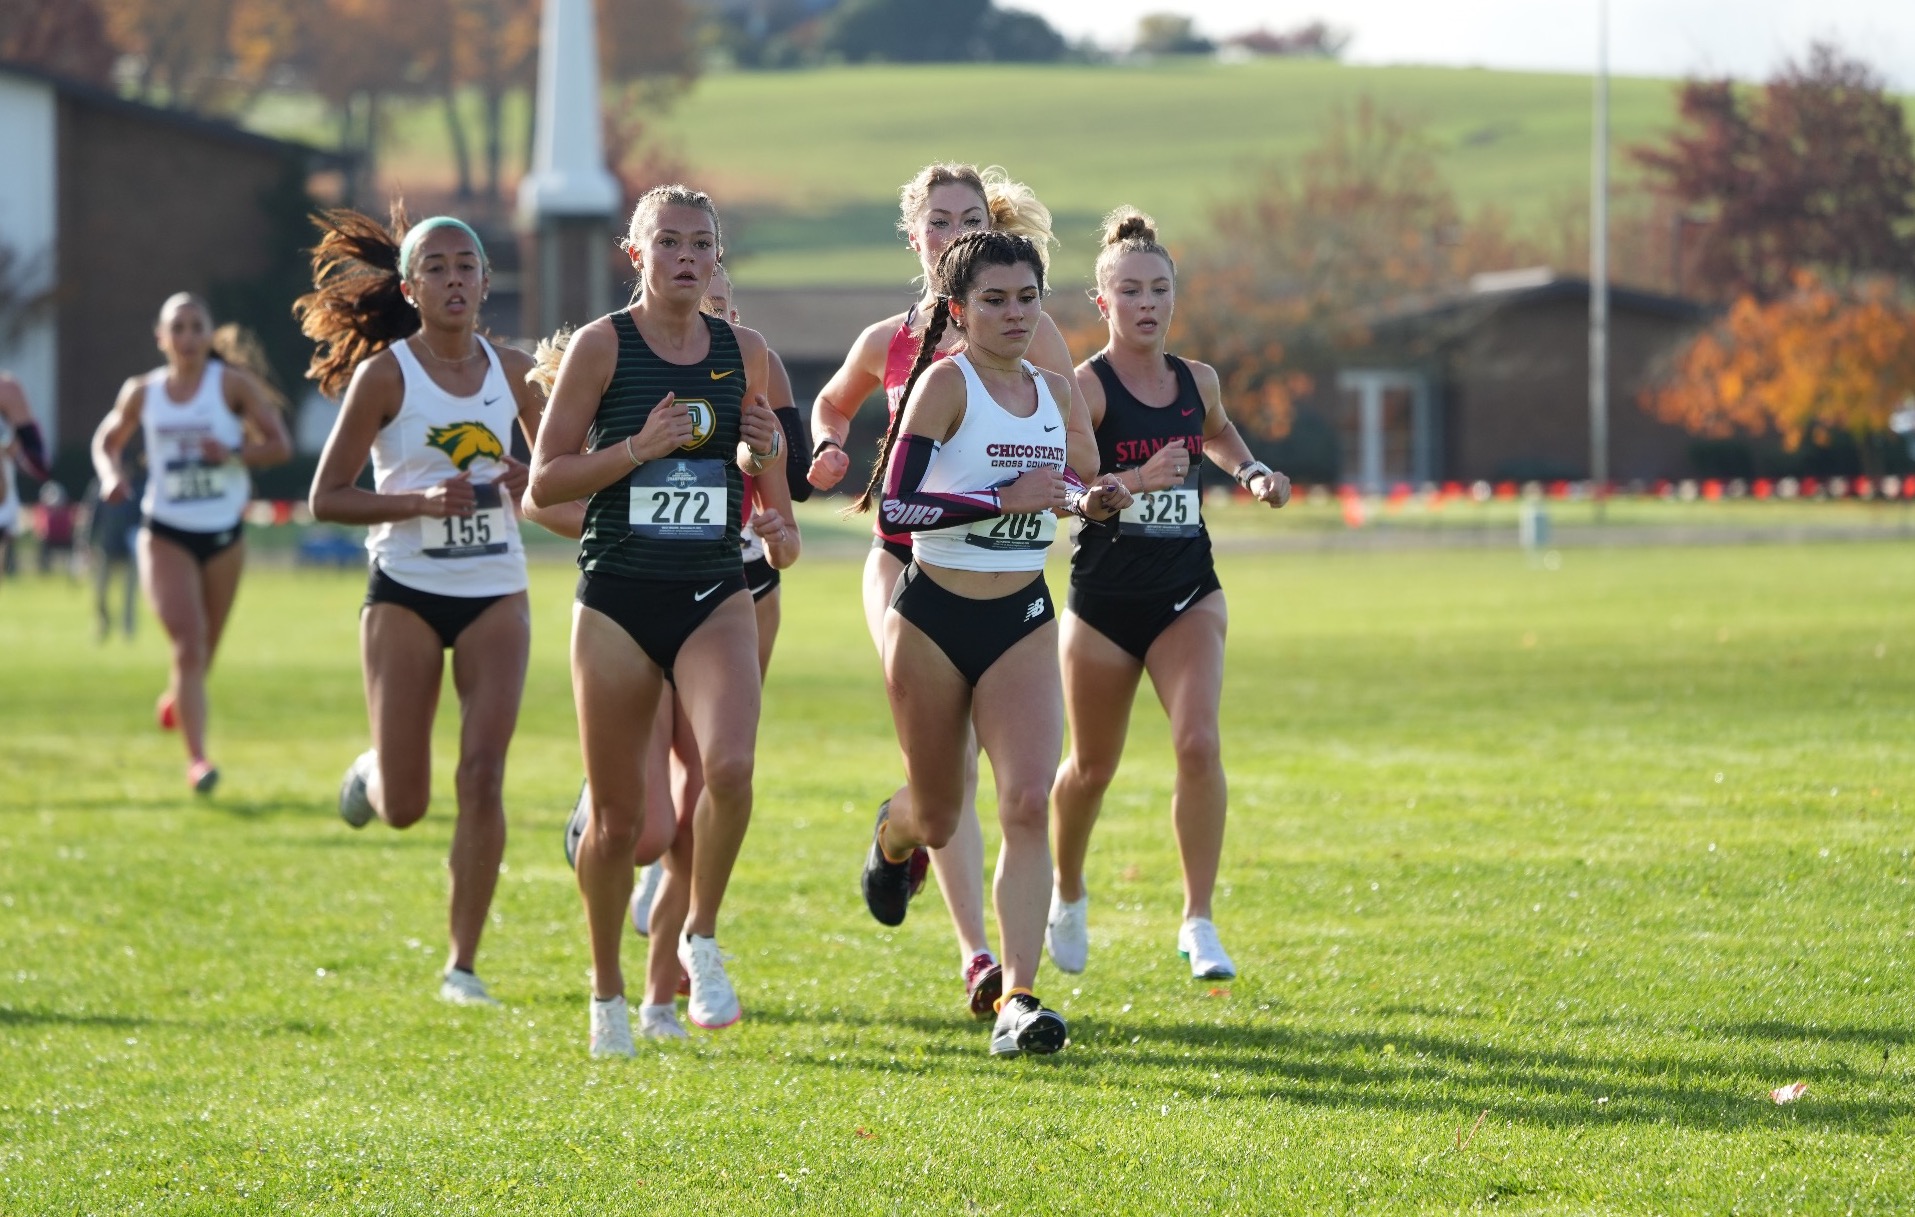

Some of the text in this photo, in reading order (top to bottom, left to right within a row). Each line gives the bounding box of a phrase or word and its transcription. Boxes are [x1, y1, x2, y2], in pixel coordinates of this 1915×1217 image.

[986, 444, 1065, 462] CHICO STATE
[991, 460, 1023, 468] CROSS
[1116, 438, 1163, 462] STAN
[651, 491, 710, 524] 272
[1139, 493, 1188, 525] 325
[443, 514, 491, 546] 155
[989, 512, 1044, 541] 205
